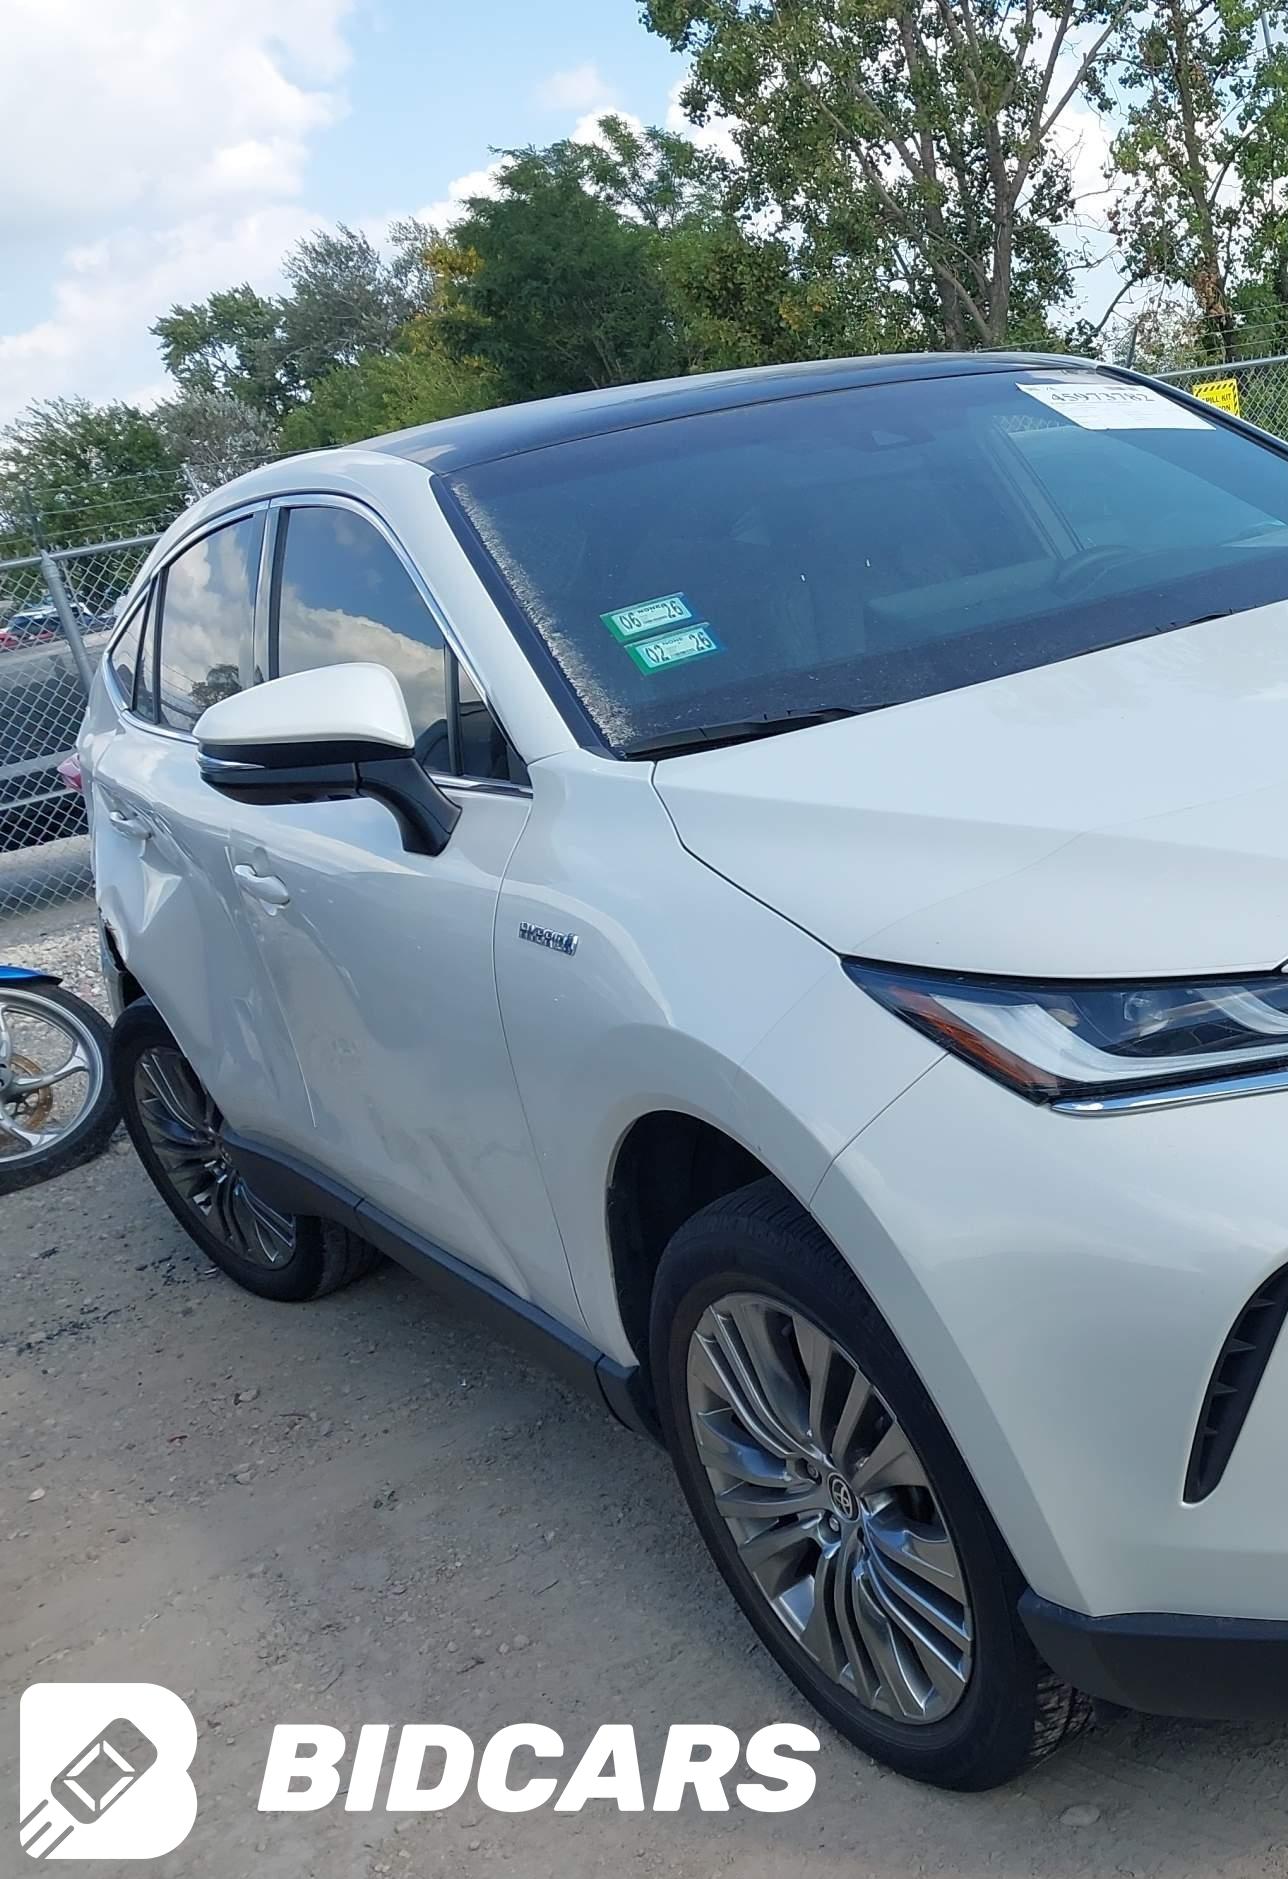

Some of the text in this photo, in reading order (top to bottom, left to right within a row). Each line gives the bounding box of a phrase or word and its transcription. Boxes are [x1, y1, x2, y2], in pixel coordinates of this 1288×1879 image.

[1222, 393, 1231, 402] KIT
[620, 612, 642, 629] 06
[664, 600, 684, 619] 26
[645, 645, 670, 664] 02
[689, 631, 712, 650] 26
